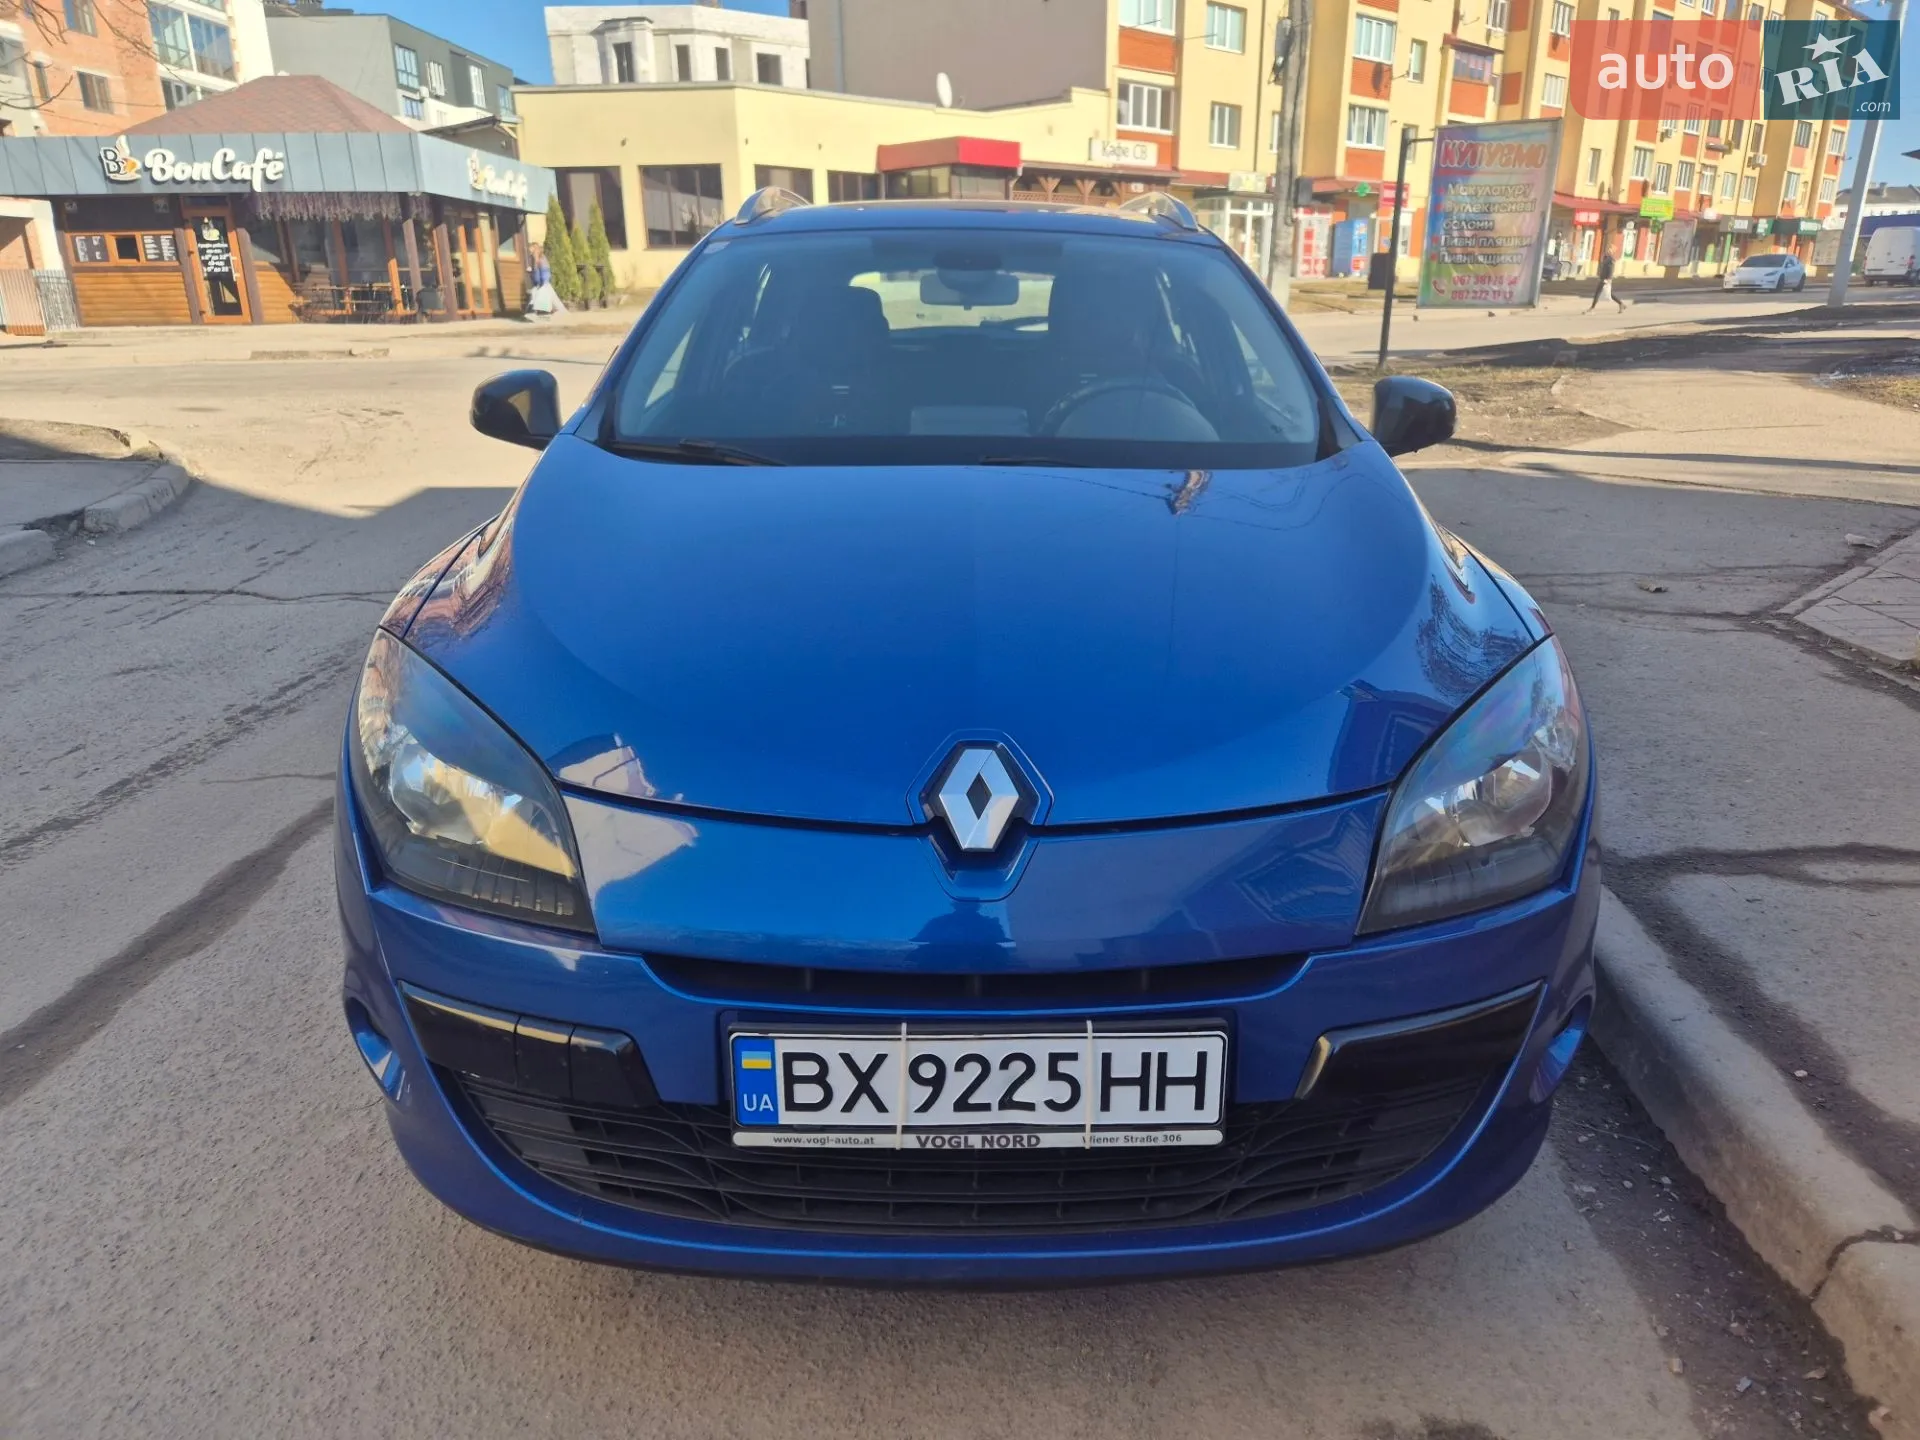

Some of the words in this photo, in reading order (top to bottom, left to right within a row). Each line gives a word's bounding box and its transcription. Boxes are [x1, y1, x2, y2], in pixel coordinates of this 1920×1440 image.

[1102, 140, 1129, 161] Кафе
[782, 1052, 890, 1113] BX
[908, 1052, 1081, 1113] 9225
[1100, 1051, 1208, 1112] HH
[743, 1093, 774, 1112] UA
[772, 1134, 876, 1146] www.vogl-auto.at
[916, 1135, 975, 1149] VOGL
[981, 1134, 1041, 1149] NORD
[1123, 1133, 1159, 1144] Straße
[1162, 1134, 1182, 1143] 306
